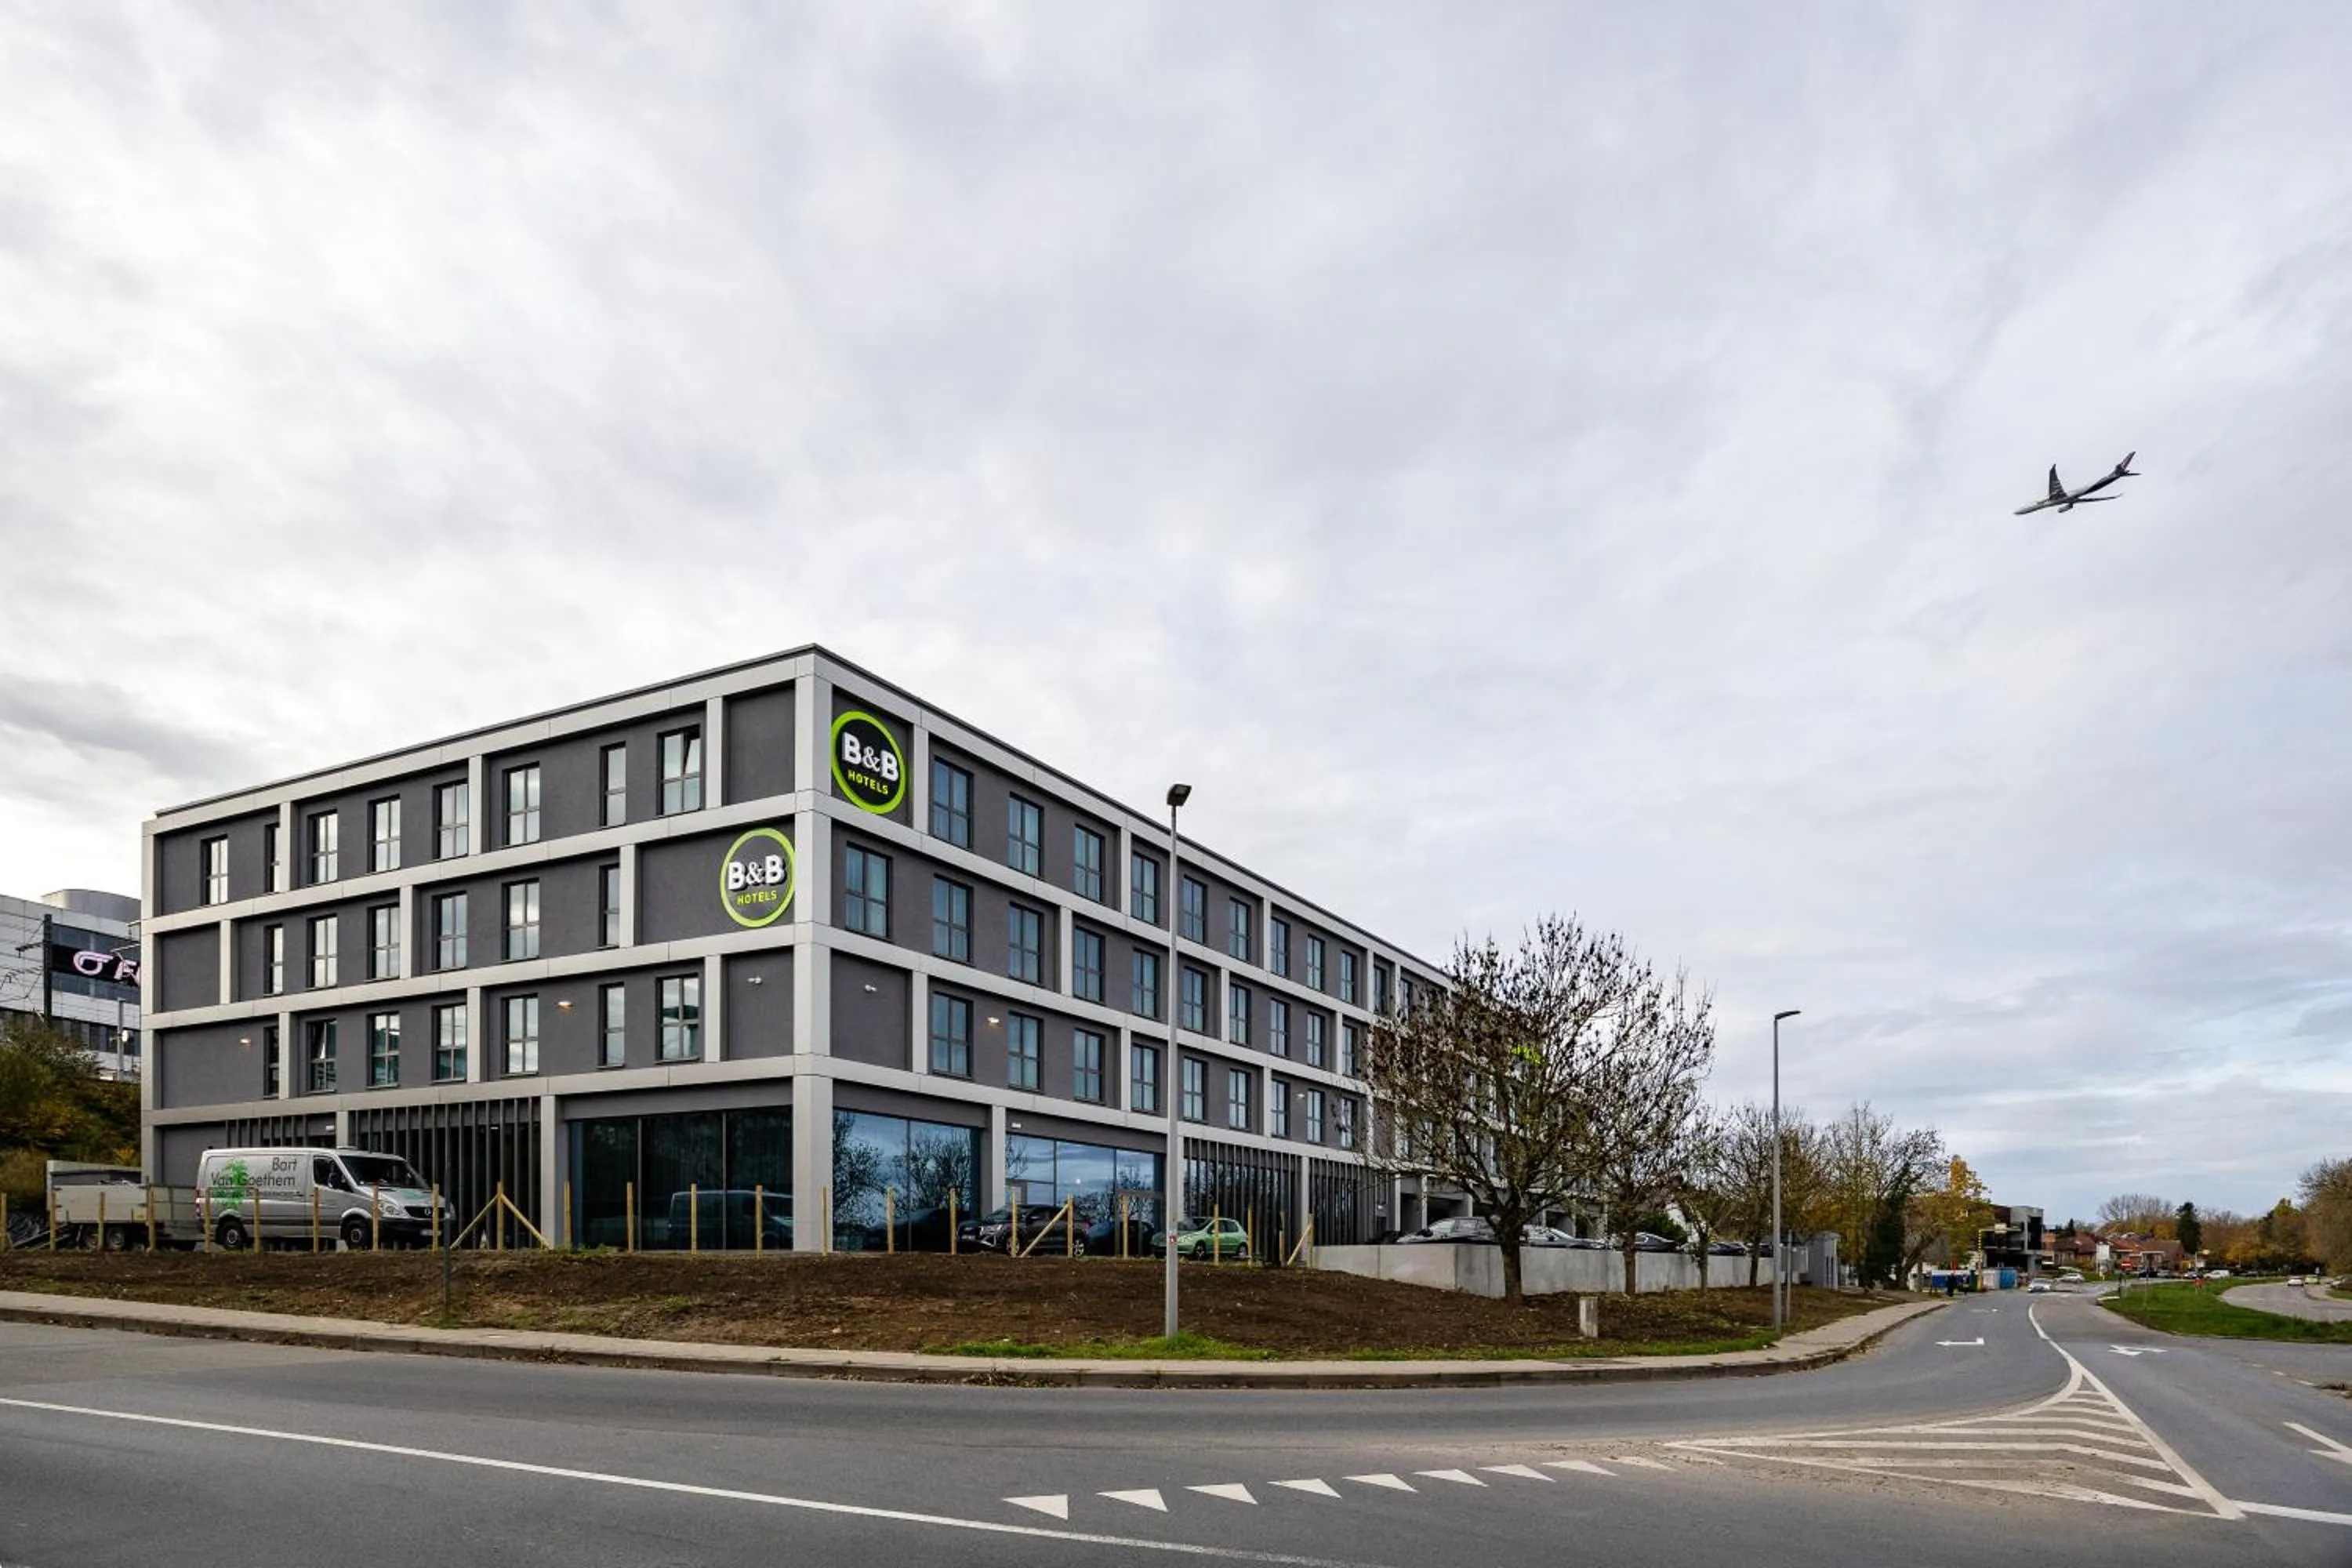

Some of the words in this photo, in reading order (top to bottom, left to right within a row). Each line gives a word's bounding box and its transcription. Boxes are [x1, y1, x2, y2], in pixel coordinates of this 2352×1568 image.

[841, 731, 899, 782] B&B
[848, 769, 889, 795] HOTELS
[728, 855, 786, 891] B&B
[736, 890, 777, 906] HOTELS
[272, 1156, 297, 1171] Bart
[211, 1171, 233, 1186] Van
[238, 1173, 296, 1186] Goethem
